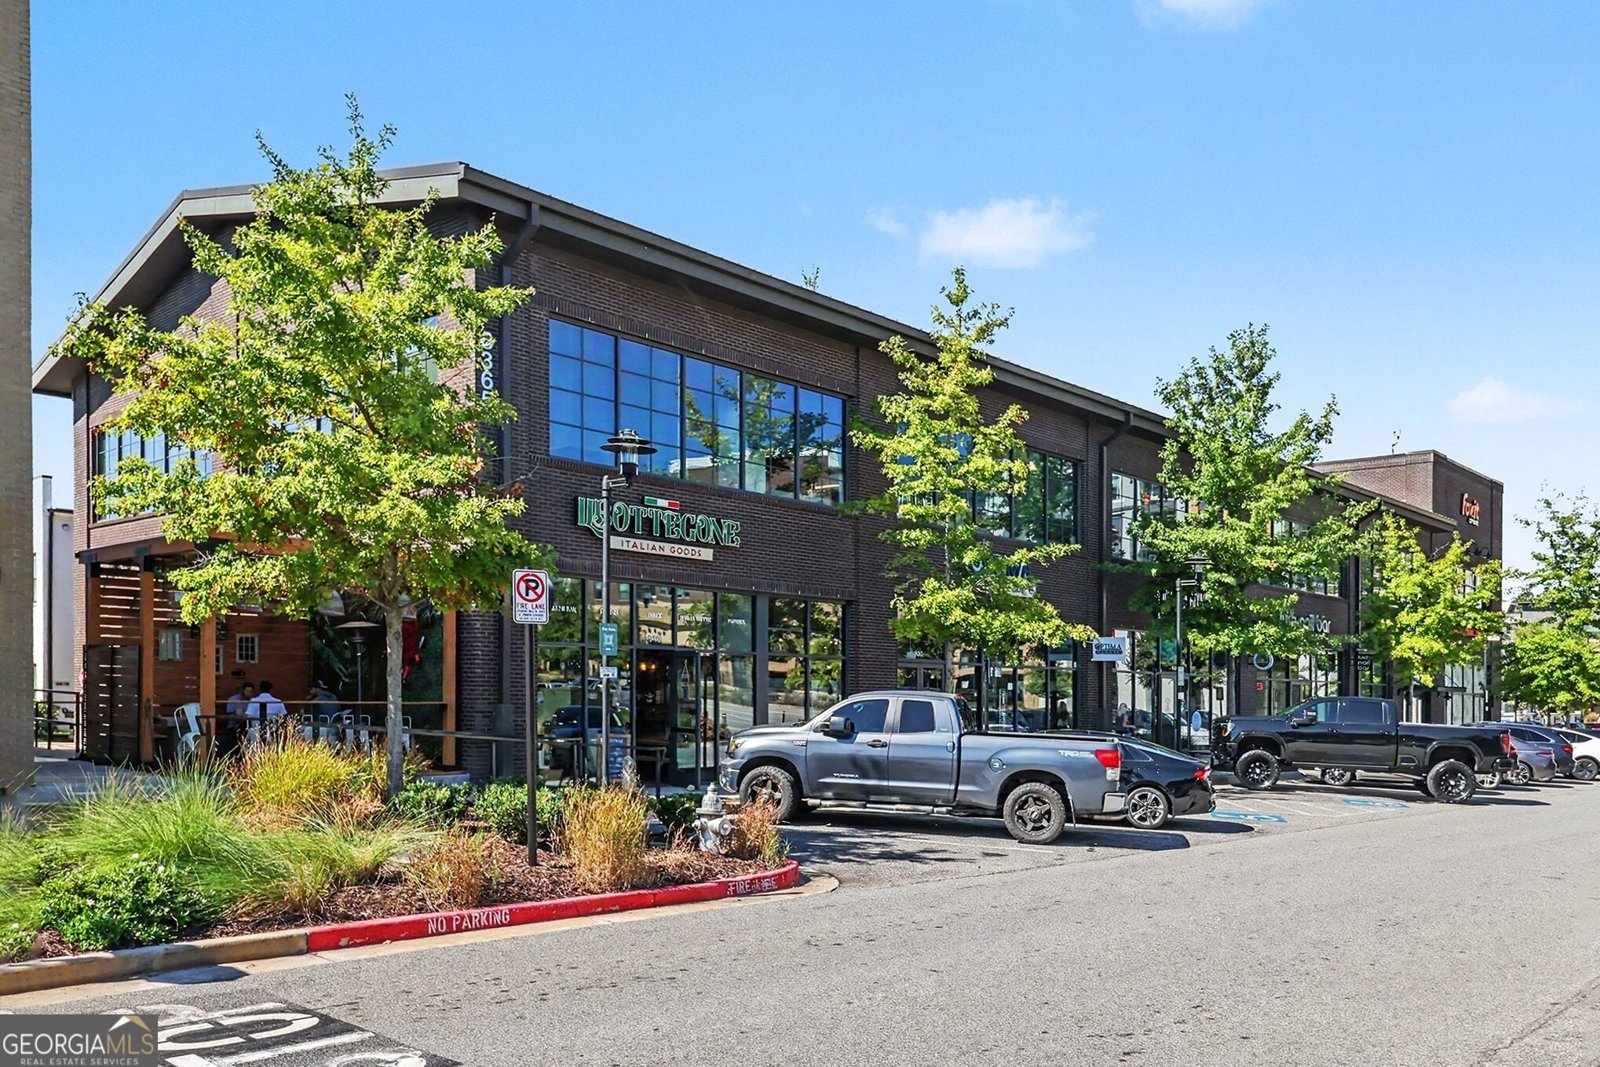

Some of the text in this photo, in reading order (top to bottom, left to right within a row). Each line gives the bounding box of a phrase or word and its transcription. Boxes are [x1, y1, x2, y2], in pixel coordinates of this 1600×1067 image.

[592, 498, 741, 547] BOTTEGONE
[621, 539, 702, 557] ITALIAN GOODS
[428, 909, 510, 934] NO PARKING
